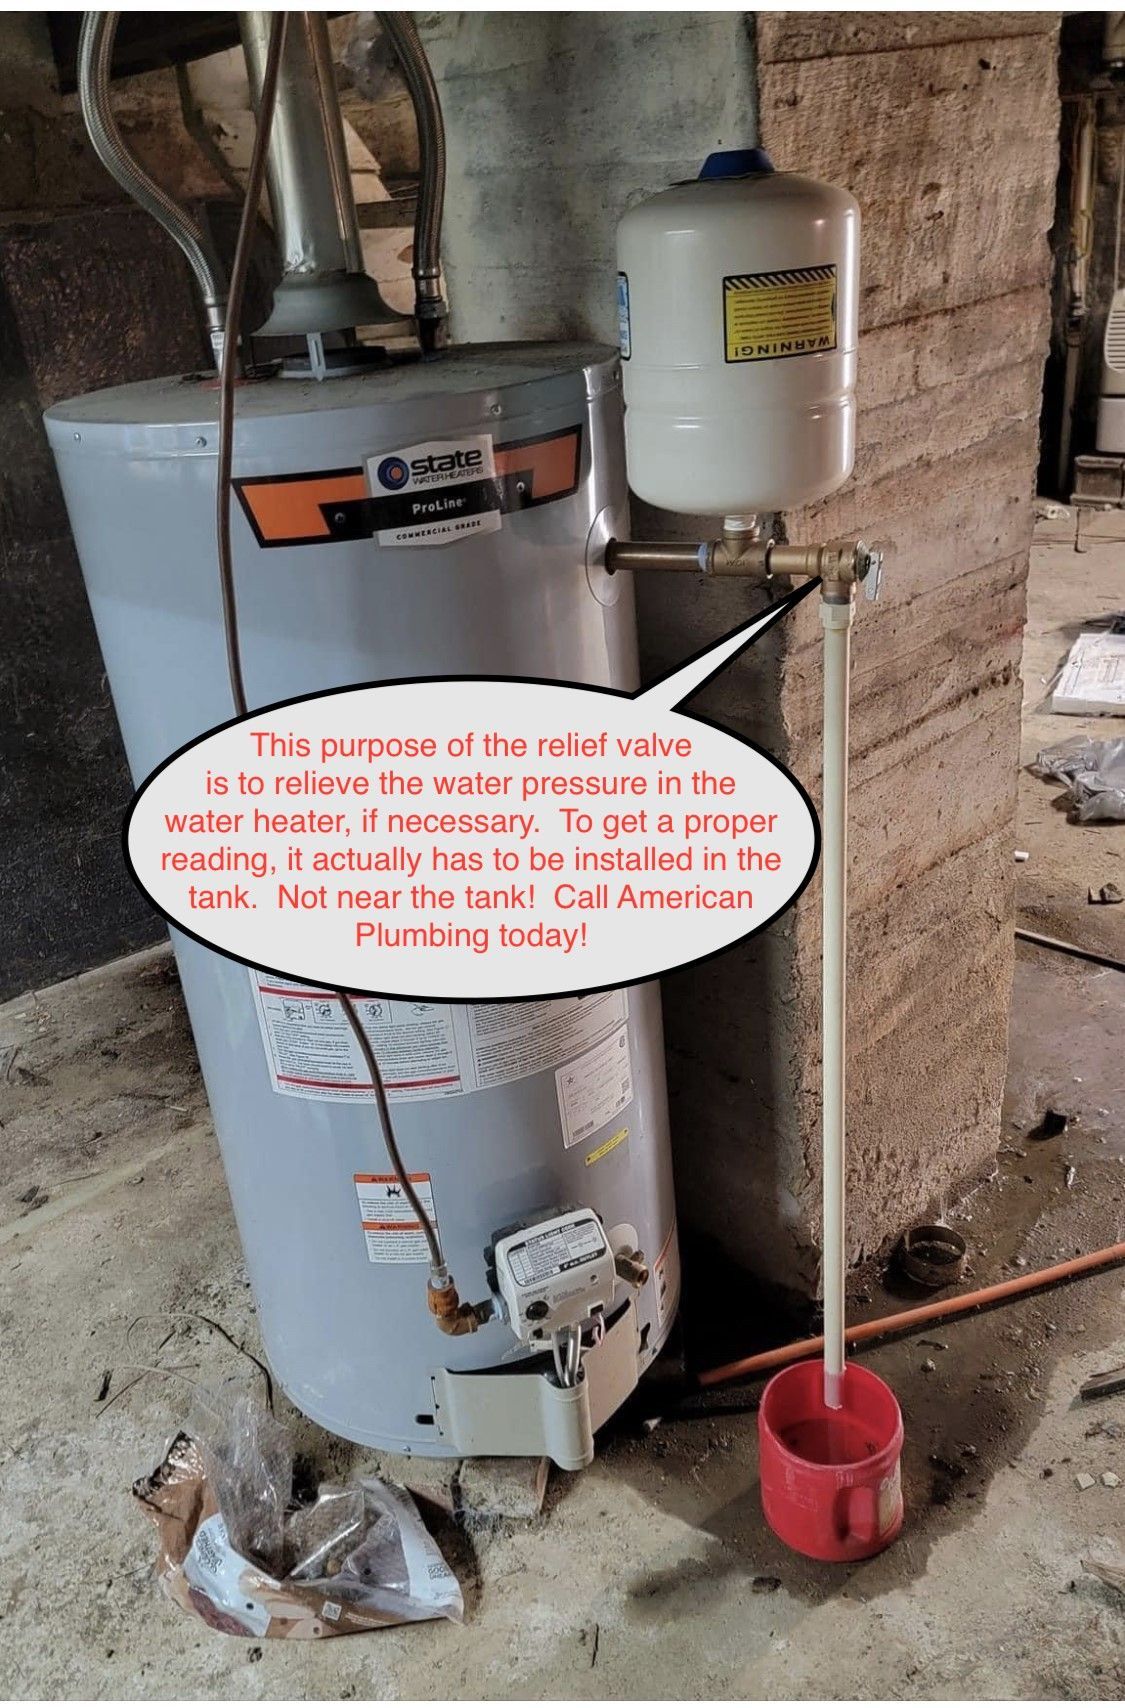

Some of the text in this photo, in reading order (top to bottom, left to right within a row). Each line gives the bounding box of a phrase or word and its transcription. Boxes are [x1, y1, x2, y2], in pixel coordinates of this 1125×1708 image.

[735, 335, 830, 357] WARNING!
[410, 449, 483, 477] state
[412, 466, 484, 485] WATER HEATERS
[396, 520, 481, 541] COMMERCIAL GRADE
